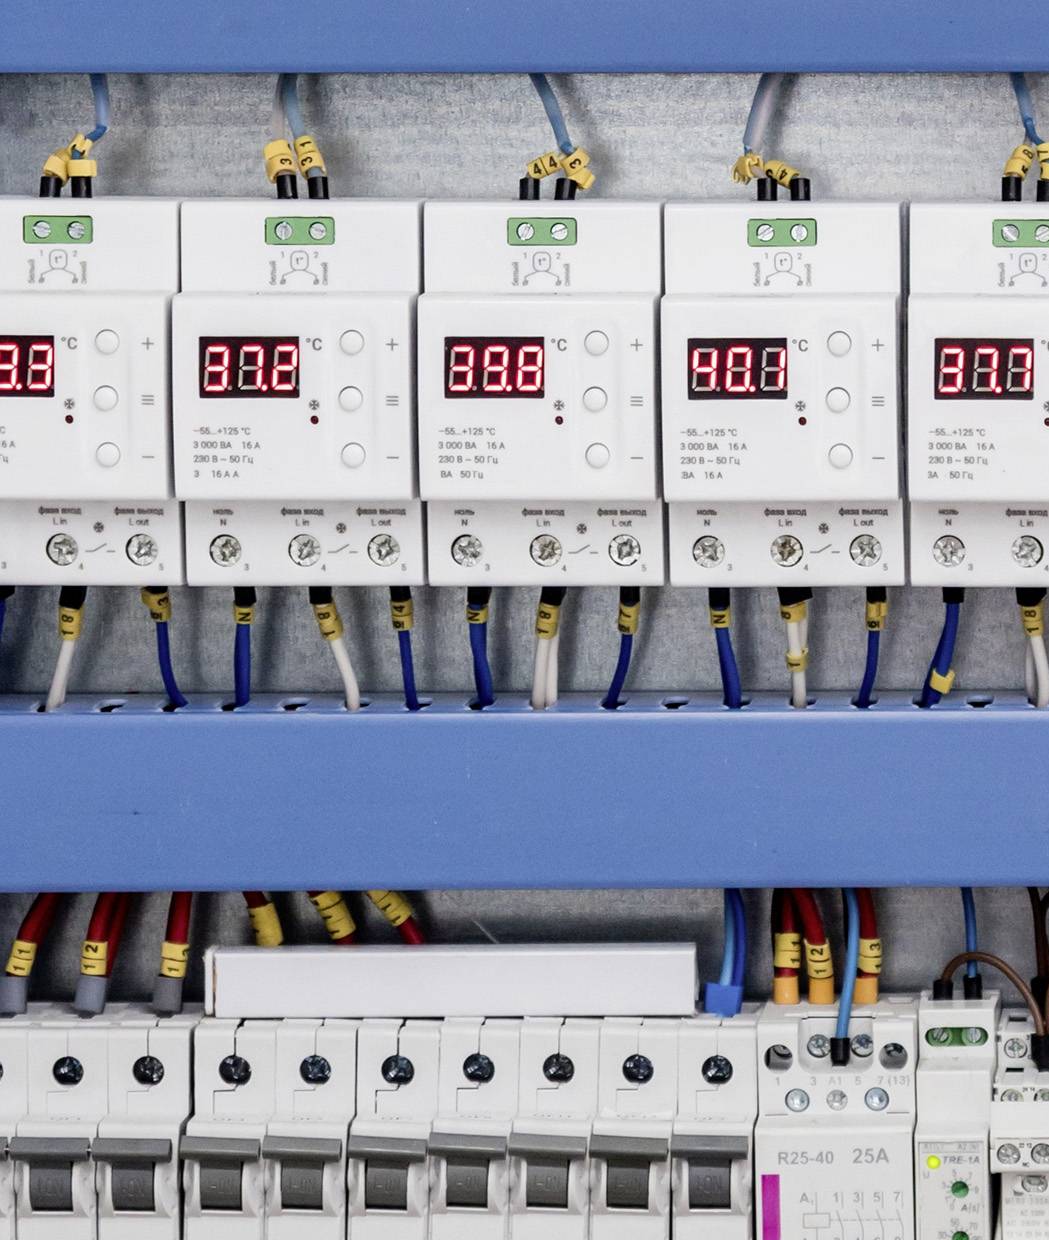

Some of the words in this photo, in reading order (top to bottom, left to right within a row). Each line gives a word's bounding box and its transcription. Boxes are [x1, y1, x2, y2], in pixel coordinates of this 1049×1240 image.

[204, 344, 299, 392] 37.2
[691, 346, 787, 393] 40.1
[938, 347, 1033, 394] 37.7
[778, 1151, 834, 1165] R25-40
[852, 1148, 889, 1164] 25A
